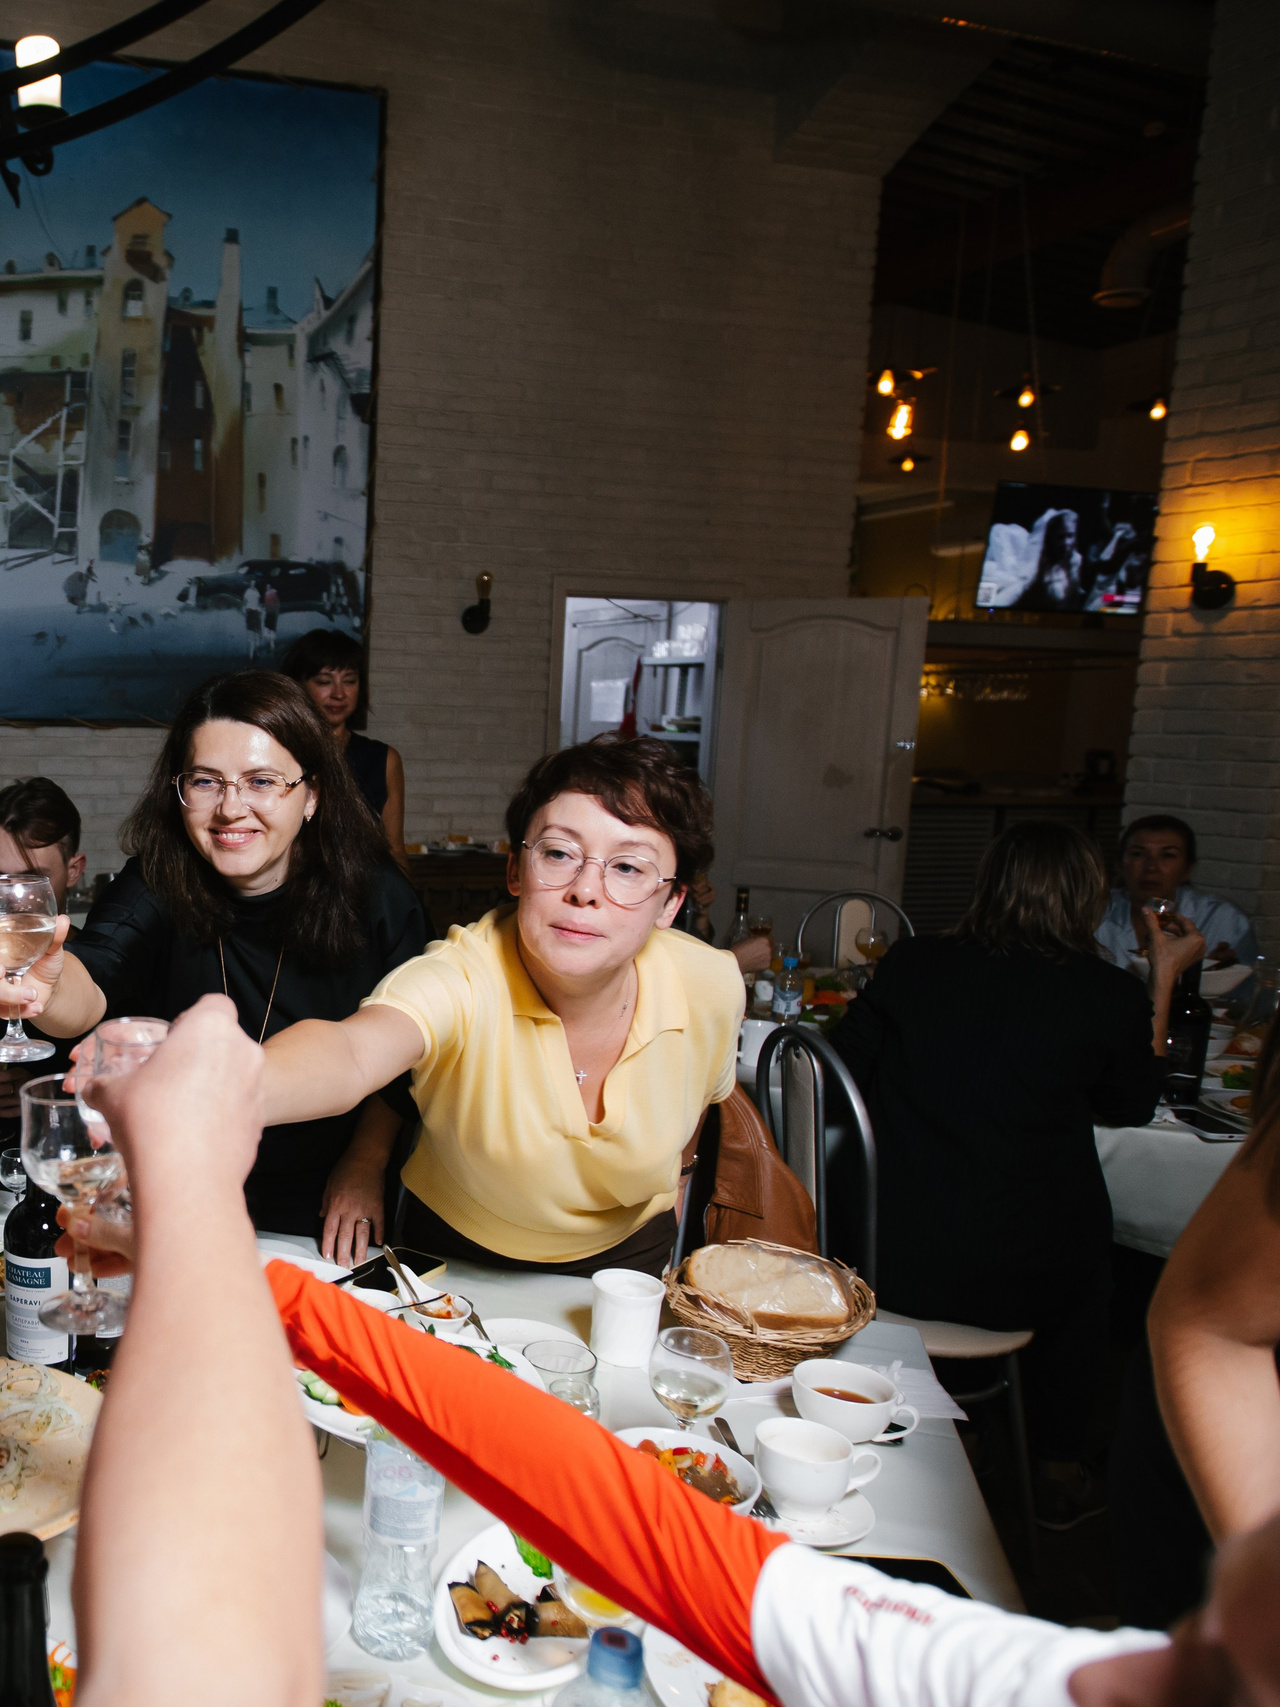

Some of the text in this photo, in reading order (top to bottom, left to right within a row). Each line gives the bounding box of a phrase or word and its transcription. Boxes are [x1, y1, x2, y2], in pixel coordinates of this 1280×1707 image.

[7, 1265, 45, 1278] CHATEAU
[8, 1272, 46, 1285] TAMAGNE
[9, 1294, 41, 1306] SAPERAVI
[11, 1315, 40, 1326] САПЕРАВИ
